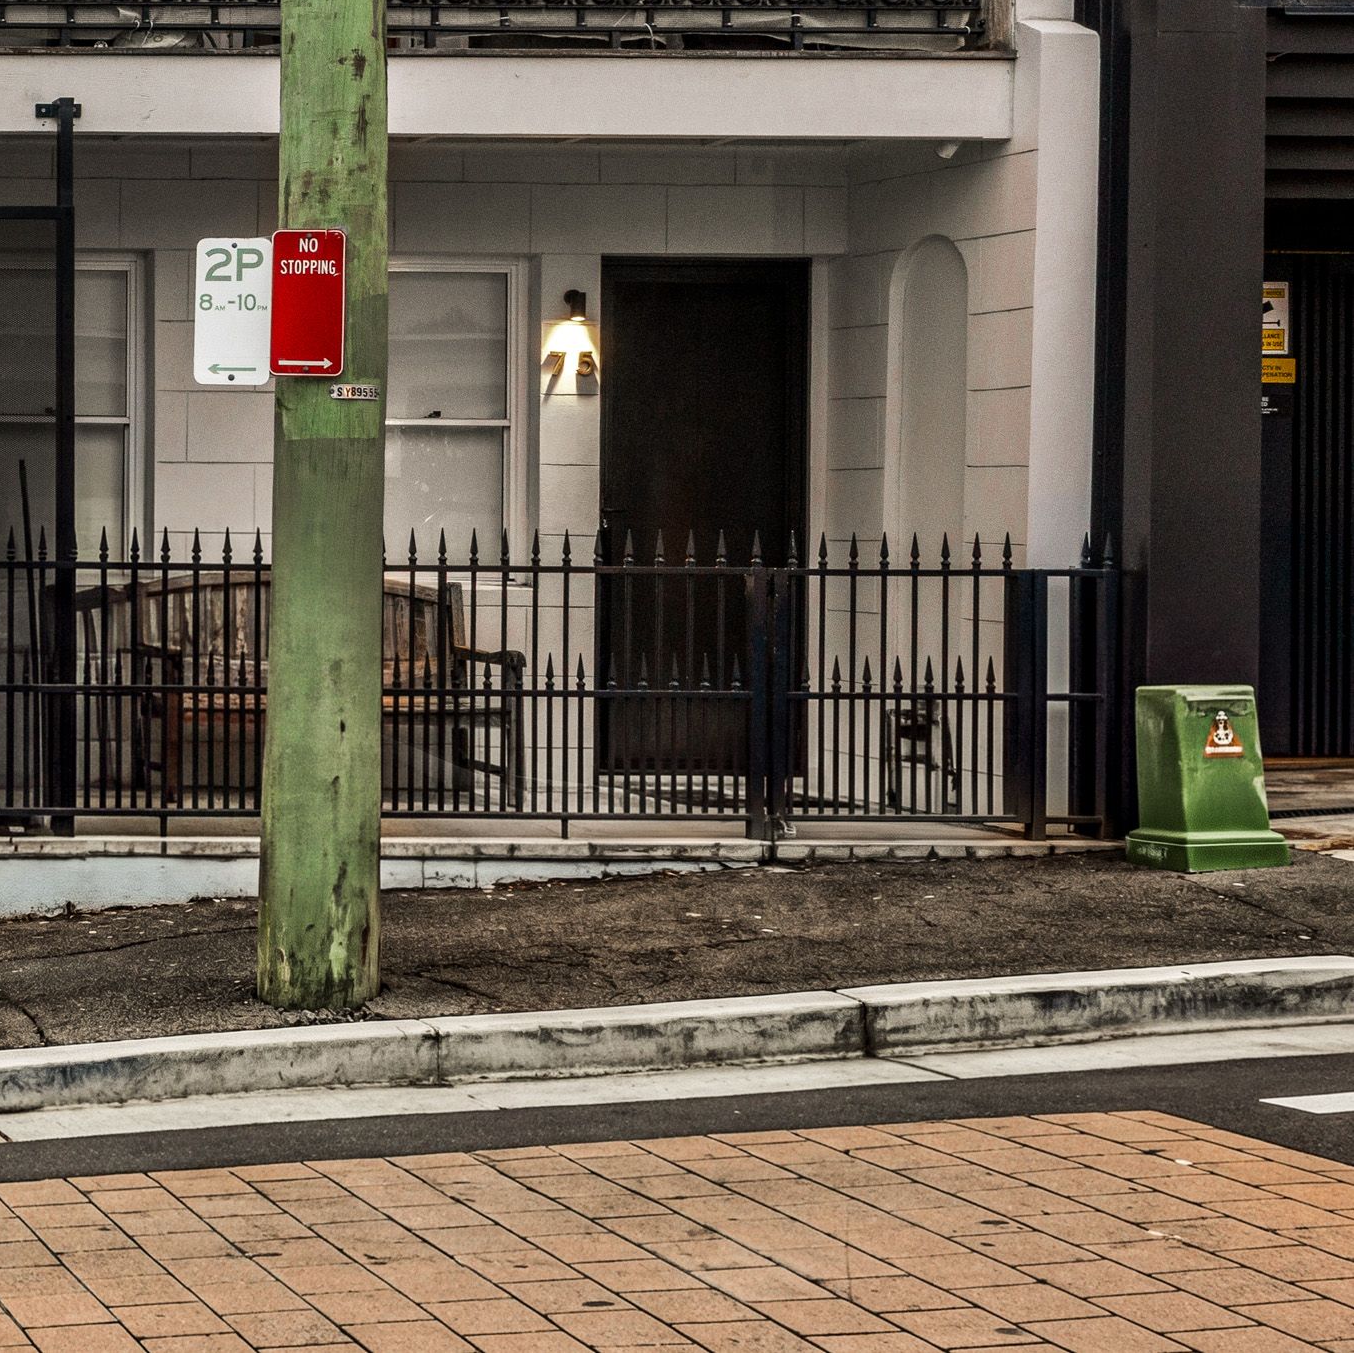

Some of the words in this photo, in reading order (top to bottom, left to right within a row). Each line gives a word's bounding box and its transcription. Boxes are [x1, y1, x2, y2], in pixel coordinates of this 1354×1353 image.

[298, 238, 319, 253] NO
[204, 248, 264, 282] 2P
[280, 260, 336, 275] STOPPING
